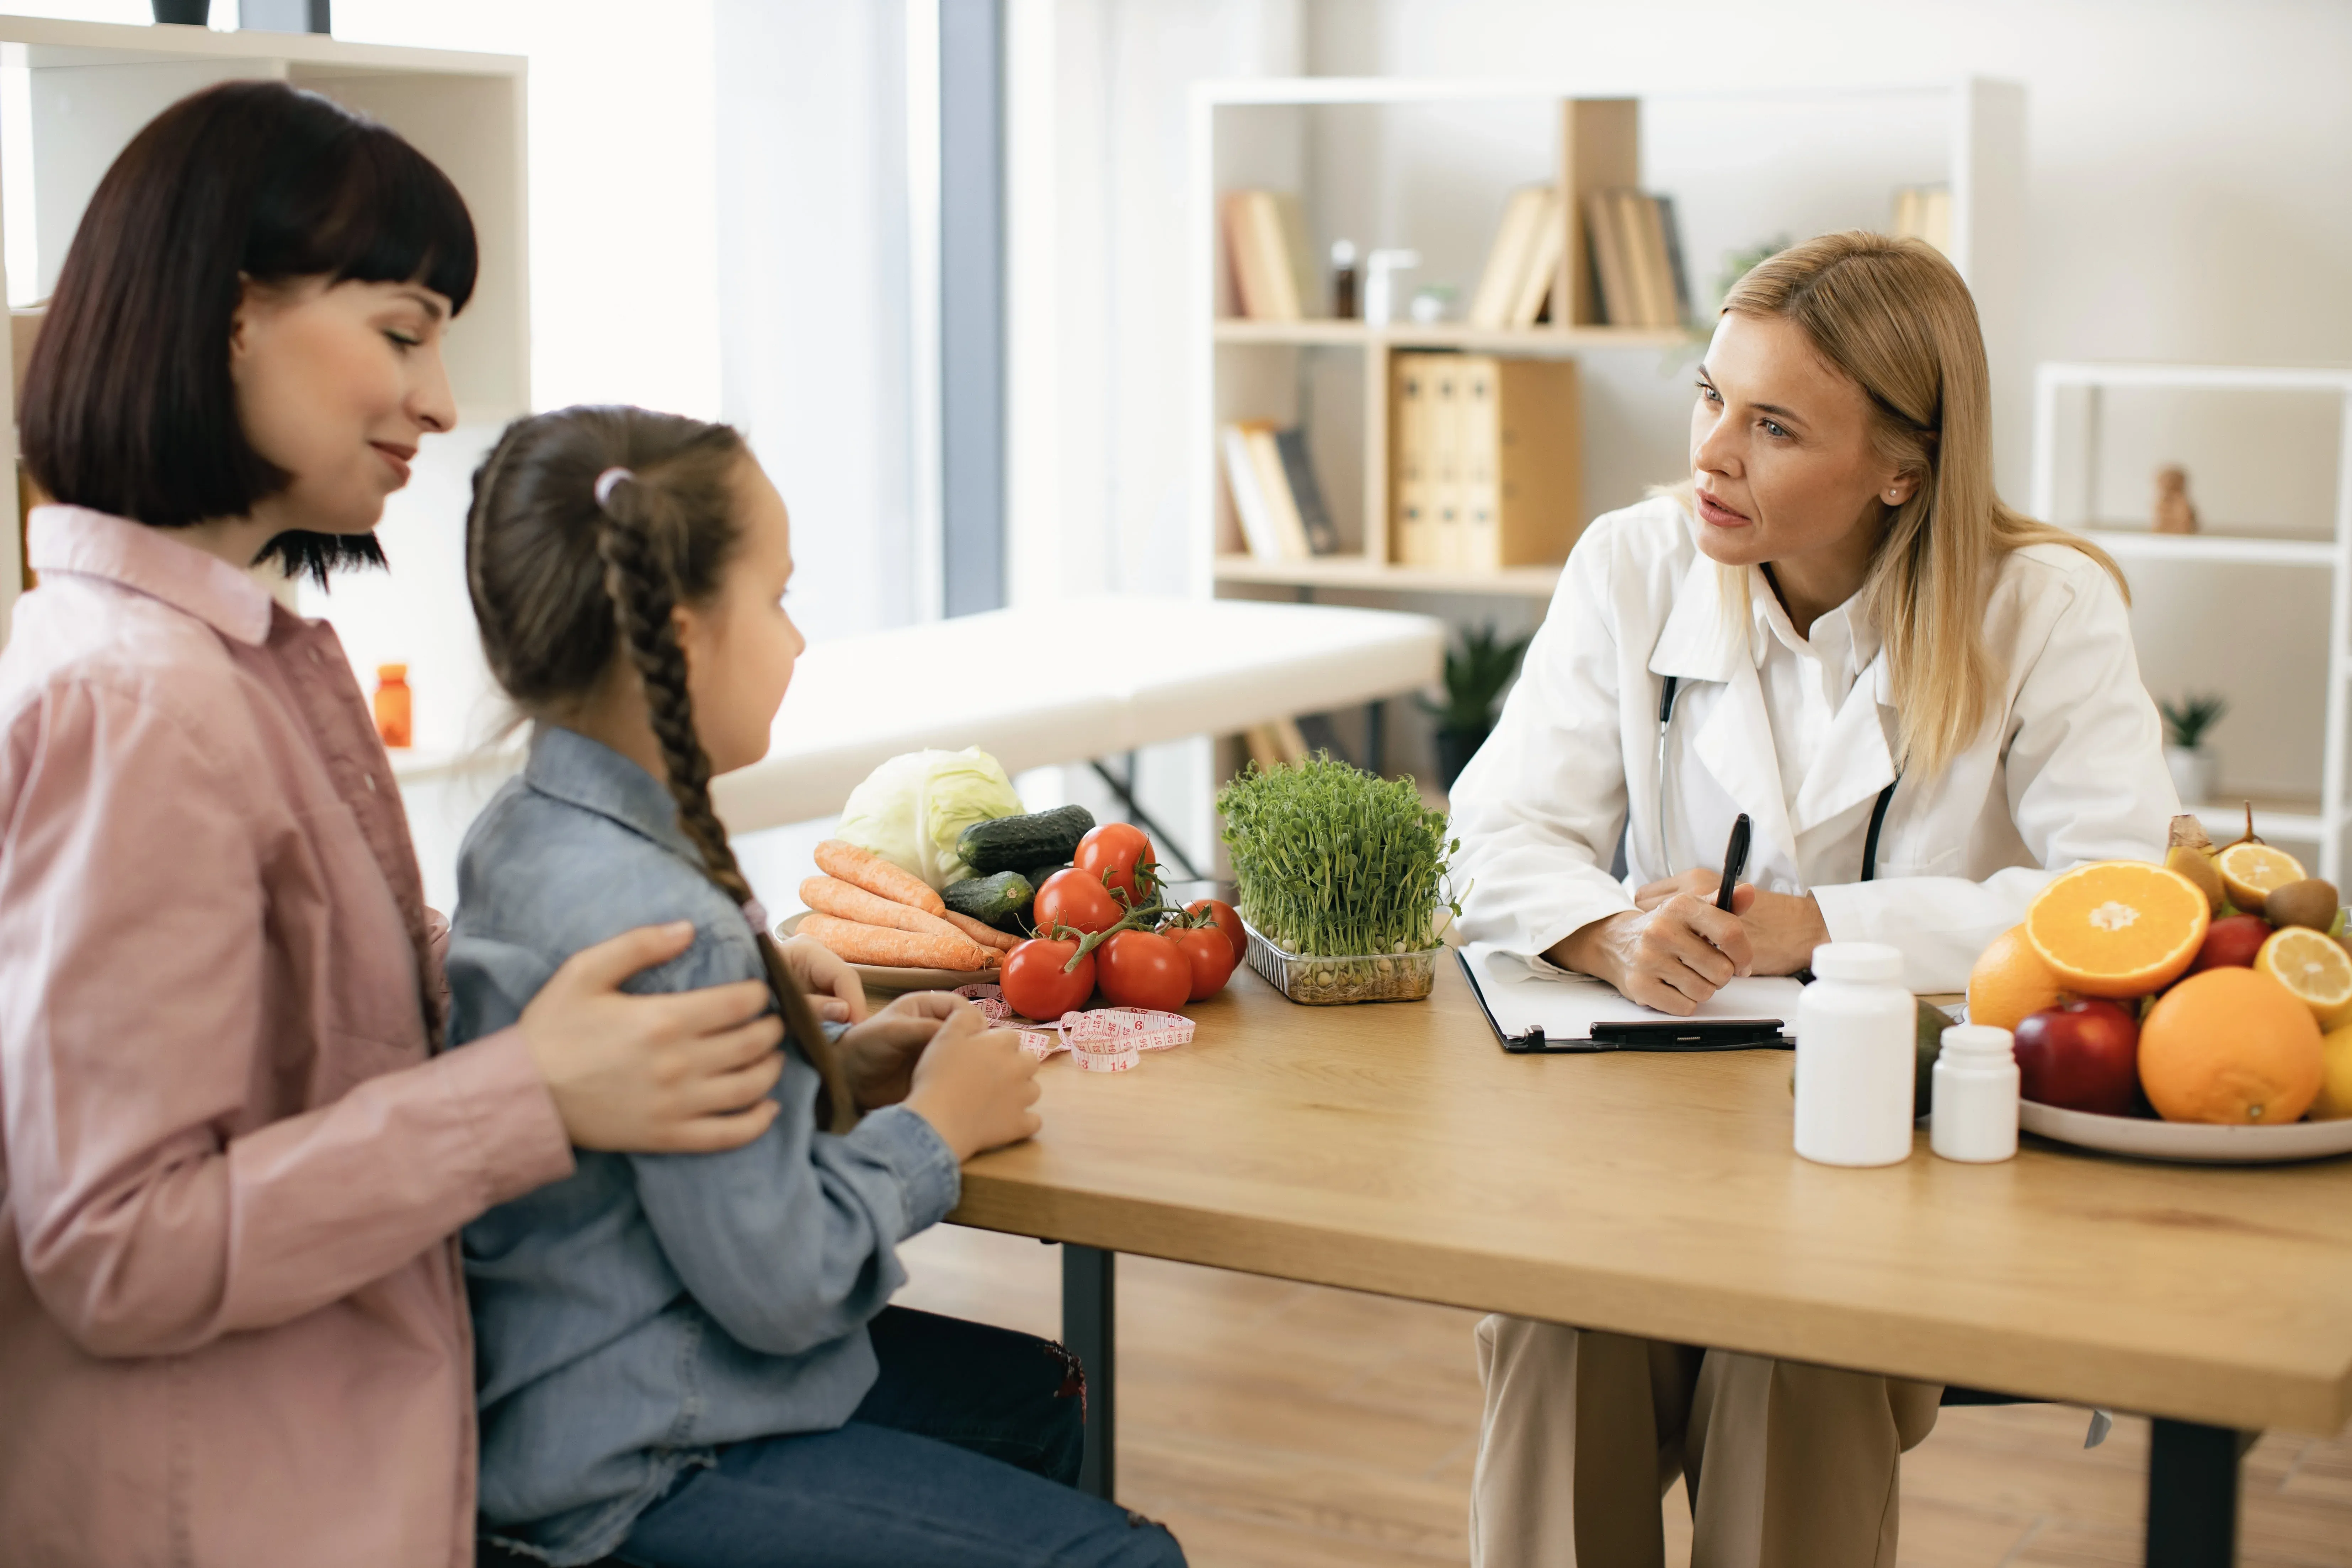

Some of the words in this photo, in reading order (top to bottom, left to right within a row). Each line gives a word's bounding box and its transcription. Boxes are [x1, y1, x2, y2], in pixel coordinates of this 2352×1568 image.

[1093, 1020, 1101, 1029] 27
[1108, 1022, 1116, 1031] 26
[1135, 1020, 1142, 1030] 6
[1154, 1037, 1162, 1045] 57
[1167, 1034, 1173, 1043] 58
[1139, 1039, 1148, 1048] 56
[1110, 1061, 1127, 1071] 14
